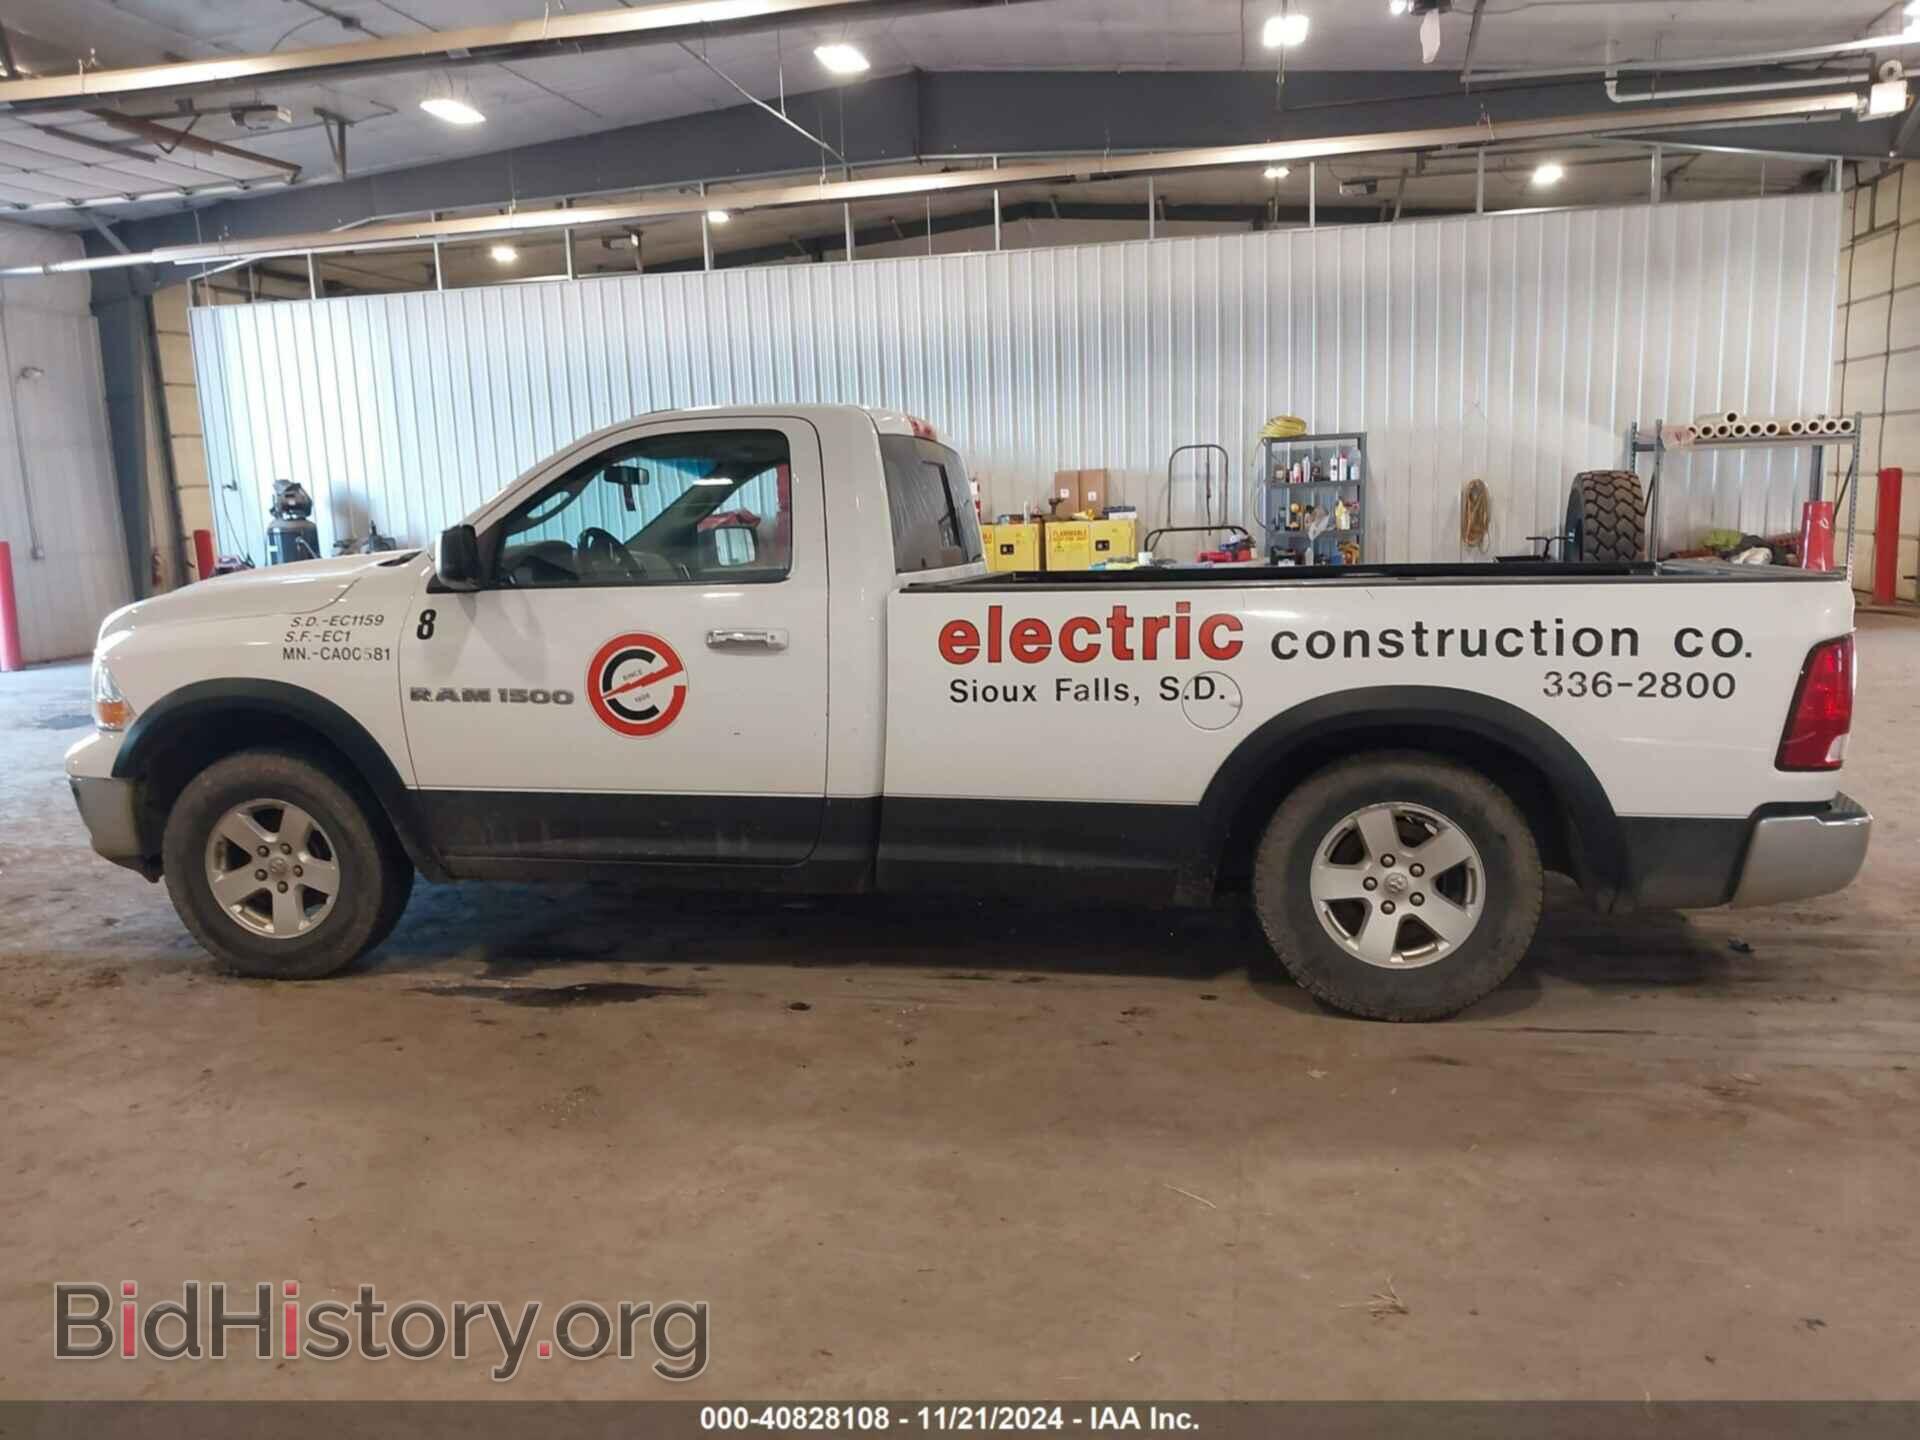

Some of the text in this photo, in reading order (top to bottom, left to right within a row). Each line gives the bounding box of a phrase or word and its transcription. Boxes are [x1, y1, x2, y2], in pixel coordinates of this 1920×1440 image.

[284, 629, 351, 643] S.F.-EC1
[290, 614, 385, 628] S.D.-EC1159
[416, 608, 437, 641] 8
[938, 601, 1752, 664] electric construction co.
[409, 687, 575, 705] RAM 1500
[949, 675, 1226, 706] Sioux Falls, S.D.
[1542, 670, 1736, 700] 336-2800
